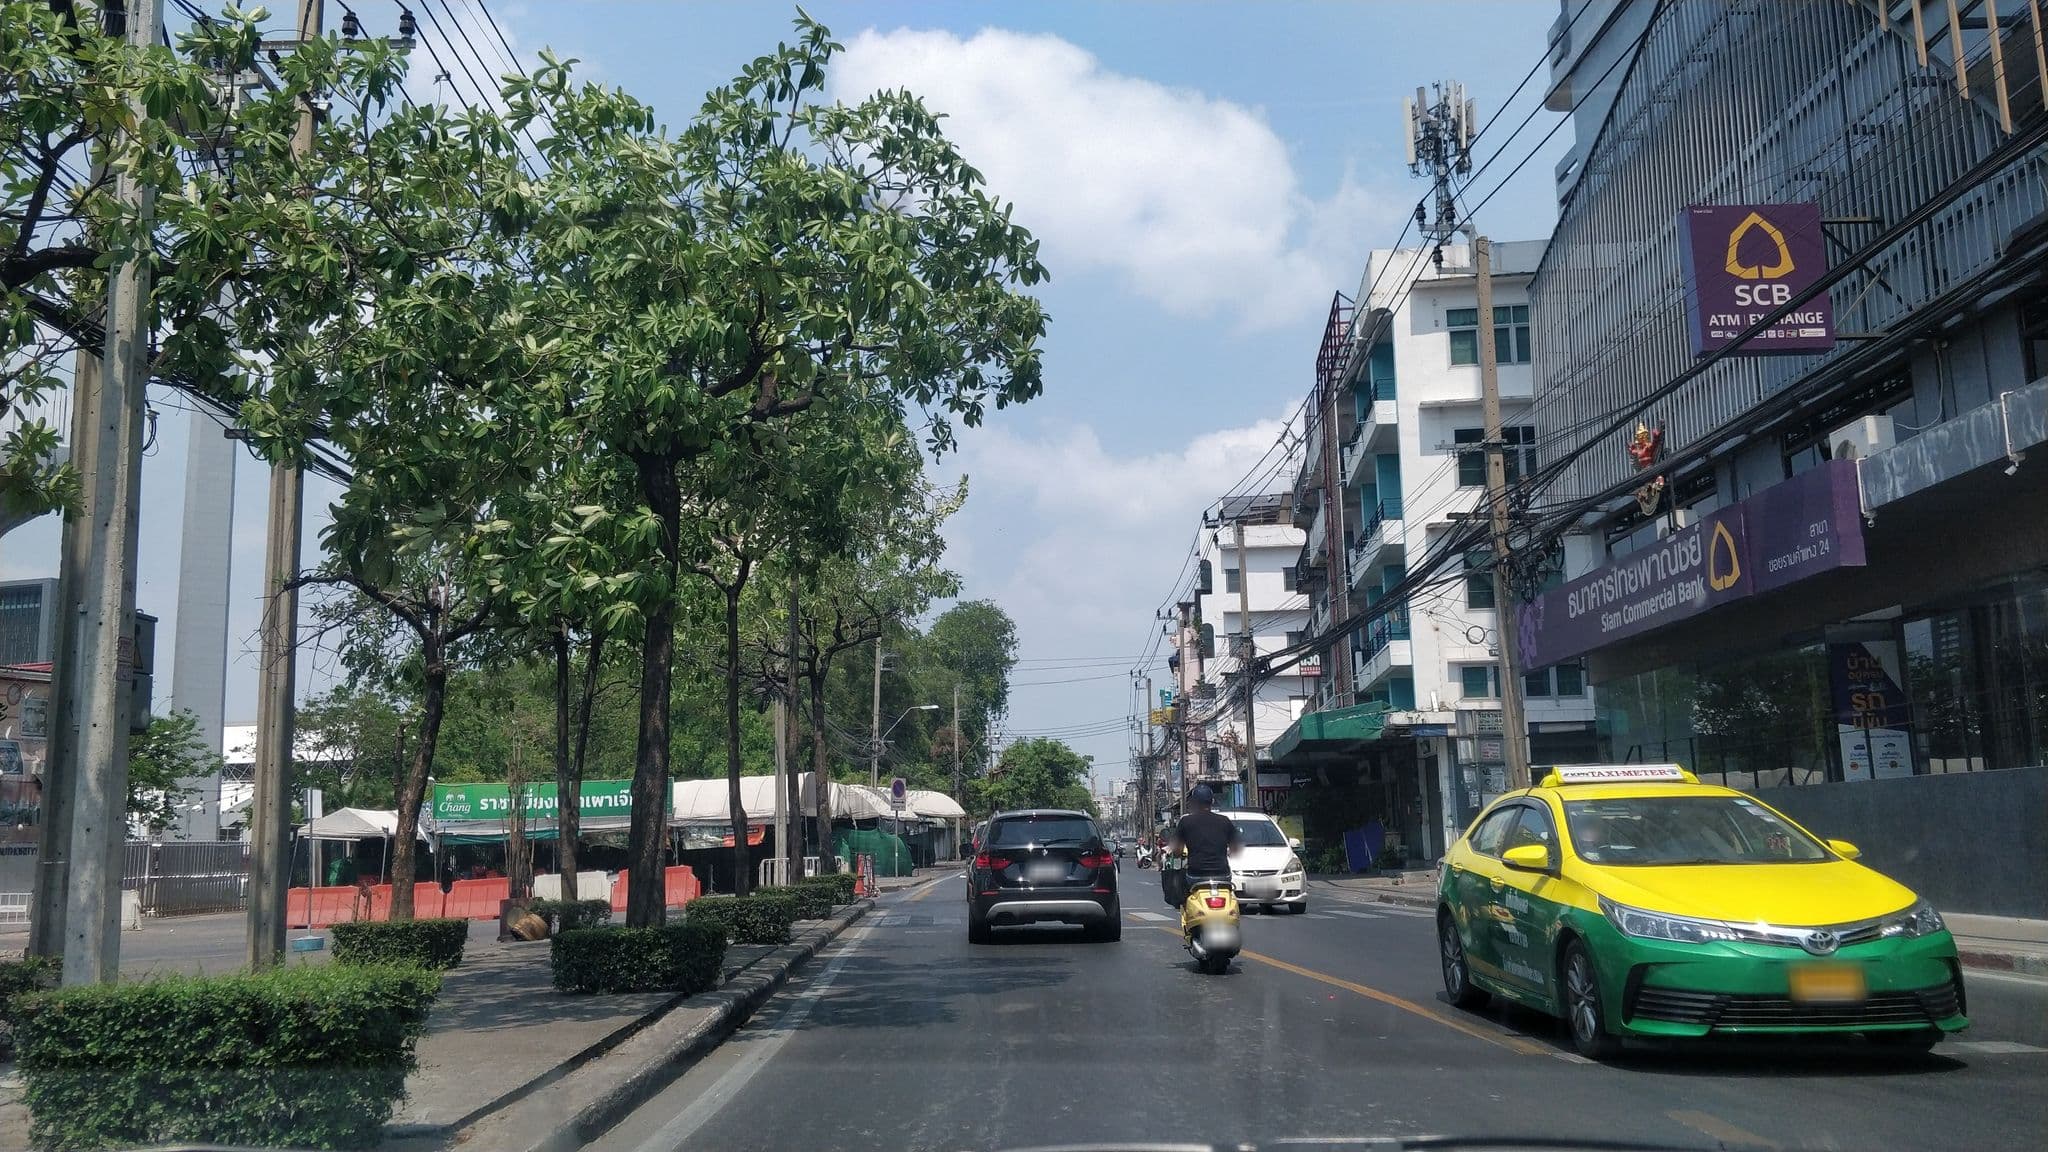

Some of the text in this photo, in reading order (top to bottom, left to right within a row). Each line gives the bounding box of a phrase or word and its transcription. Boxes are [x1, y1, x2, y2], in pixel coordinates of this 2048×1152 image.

[1735, 284, 1791, 306] SCB
[1709, 314, 1740, 326] ATM
[1819, 538, 1830, 555] 24
[1568, 523, 1702, 619] ธนาคารไทยพาณิชย์
[1601, 574, 1705, 633] Siam Commercial Bank
[440, 802, 471, 813] Chang
